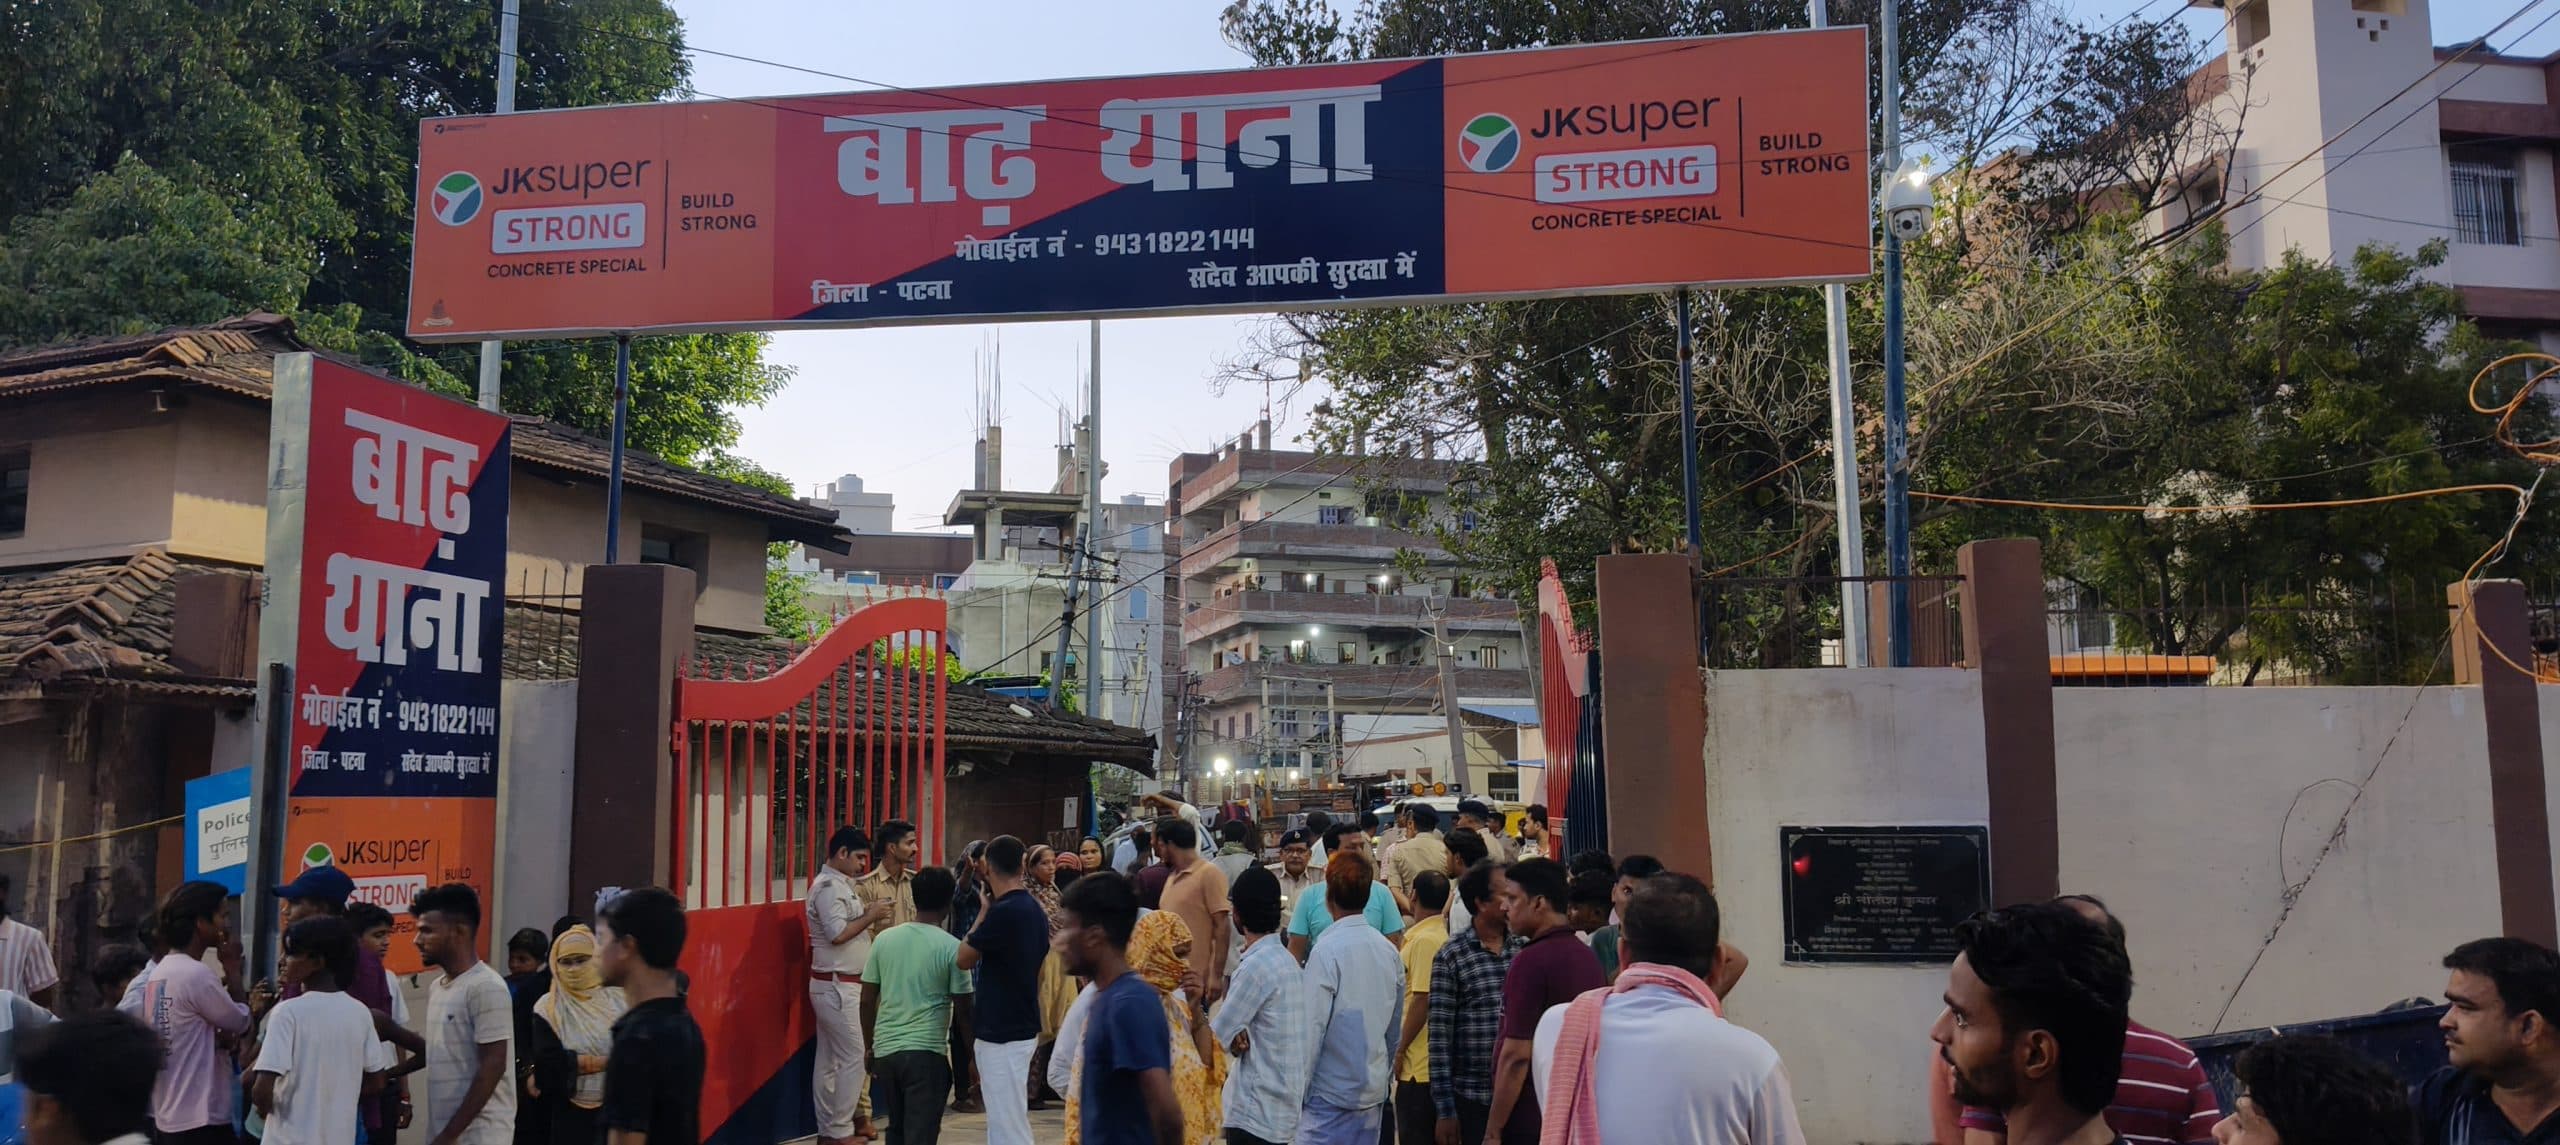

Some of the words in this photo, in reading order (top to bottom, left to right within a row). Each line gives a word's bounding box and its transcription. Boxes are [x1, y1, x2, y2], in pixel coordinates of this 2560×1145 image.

[1531, 97, 1721, 142] JKsuper
[824, 104, 1047, 226] बाढ़
[1100, 84, 1382, 192] थाना
[1759, 132, 1823, 152] BUILD
[492, 159, 651, 199] JKsuper
[1552, 155, 1700, 193] STRONG
[1760, 155, 1851, 176] STRONG
[680, 193, 735, 210] BUILD
[506, 212, 631, 244] STRONG
[680, 214, 757, 231] STRONG
[1531, 210, 1637, 231] CONCRETE
[1641, 205, 1722, 224] SPECIAL
[954, 231, 1040, 263] मोबाईल
[1047, 229, 1069, 258] नं
[1095, 228, 1255, 256] 9431822144
[487, 261, 576, 278] CONCRETE
[579, 258, 648, 274] SPECIAL
[1188, 261, 1237, 289] सदैव
[1246, 256, 1320, 286] आपकी
[1326, 258, 1388, 290] सुरक्षा
[1394, 251, 1418, 279] में
[810, 279, 871, 305] जिला
[897, 279, 953, 301] पटना
[344, 408, 479, 560] बाढ़
[324, 552, 490, 674] थाना
[302, 684, 364, 732] मोबाईल
[367, 689, 384, 729] नं
[399, 701, 496, 735] 9431822144
[301, 744, 329, 771] जिला
[340, 751, 366, 771] पटना
[339, 839, 431, 870] JKsuper
[445, 867, 471, 880] BUILD
